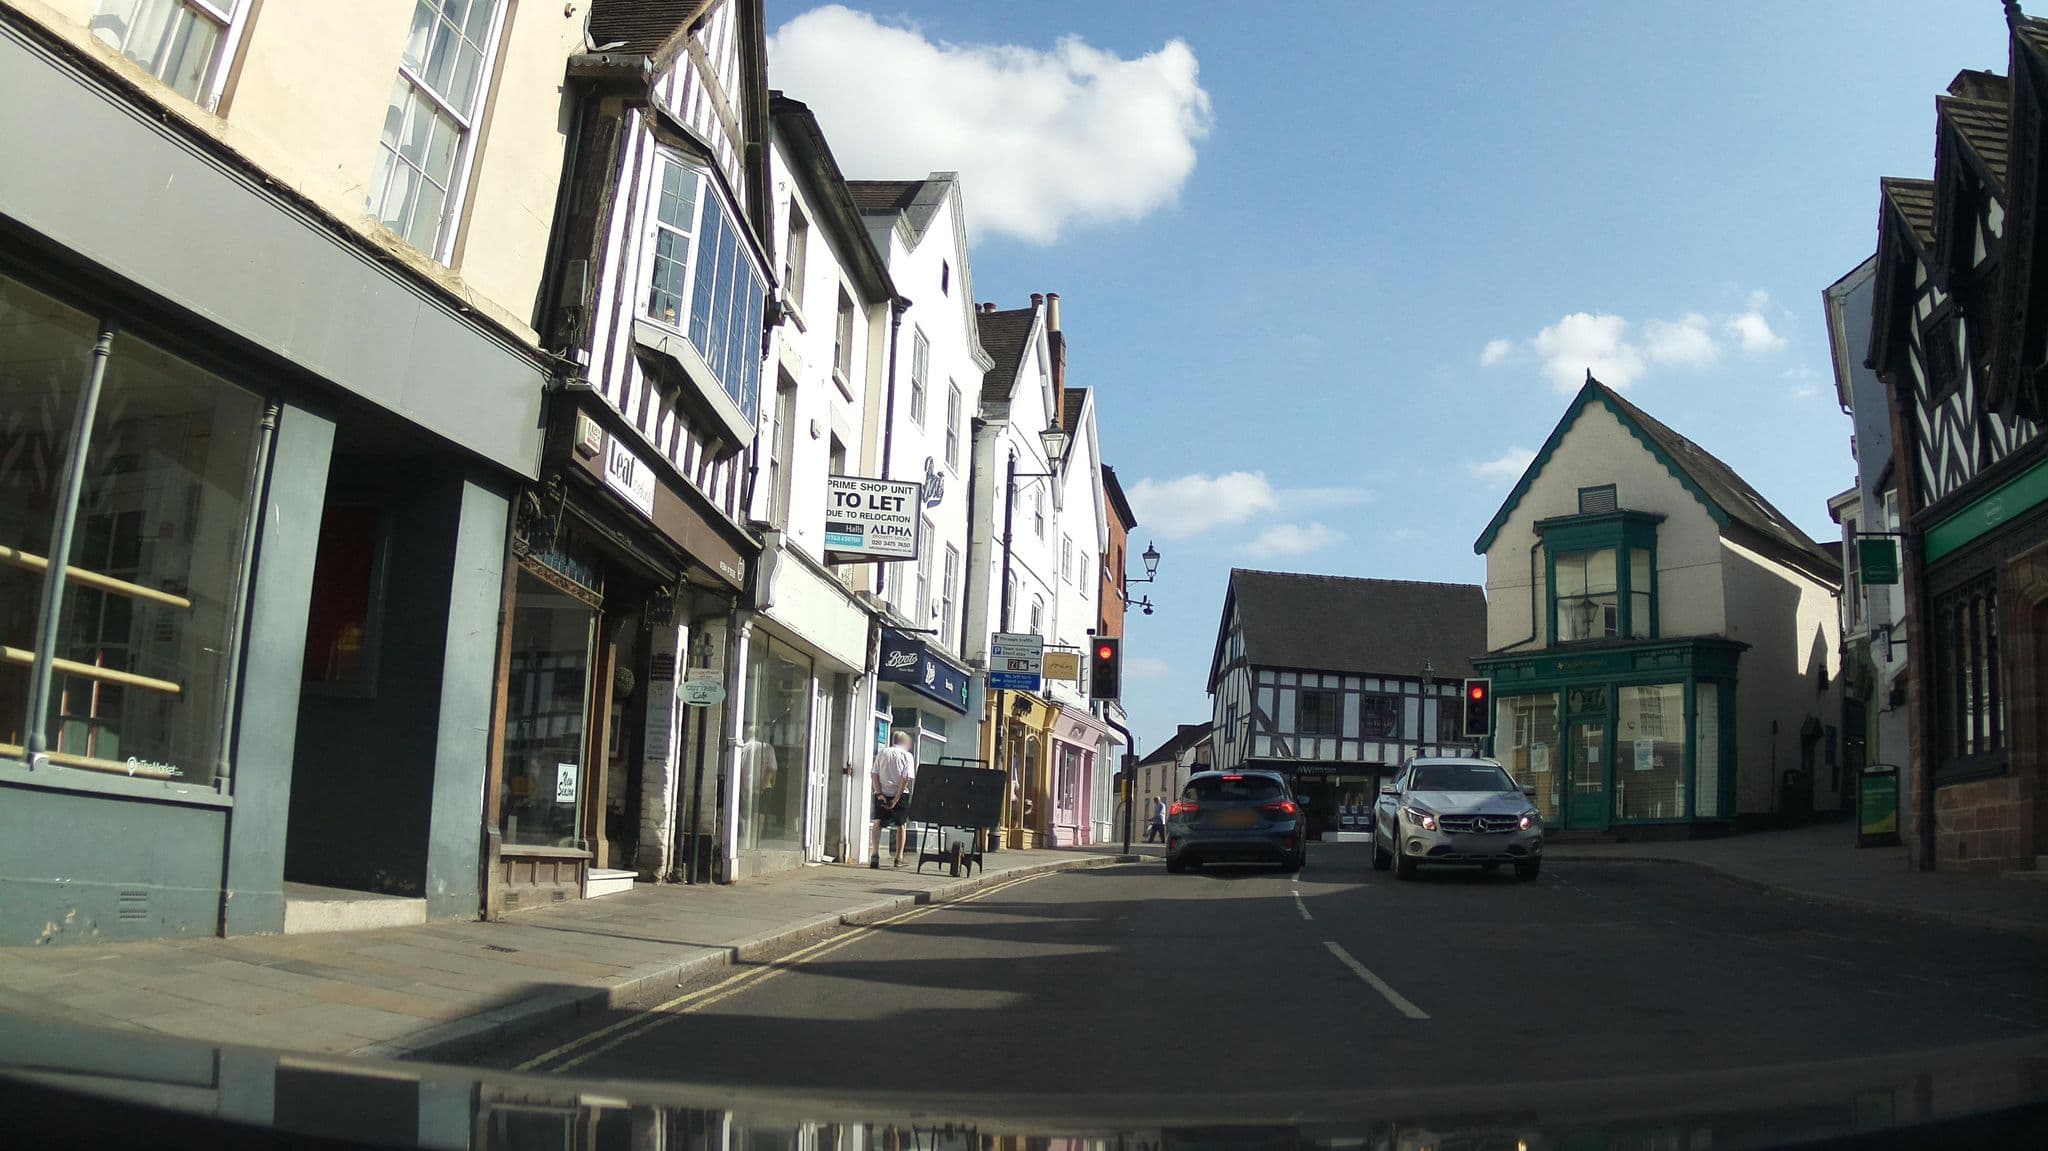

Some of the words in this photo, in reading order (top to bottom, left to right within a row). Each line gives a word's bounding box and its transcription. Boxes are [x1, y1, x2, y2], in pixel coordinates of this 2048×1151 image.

[609, 439, 636, 489] Leaf
[860, 482, 888, 493] SHOP
[891, 485, 914, 495] UNIT
[834, 491, 862, 508] TO
[869, 494, 905, 512] LET
[826, 509, 843, 517] DUE
[846, 510, 857, 519] TO
[859, 512, 911, 523] RELOCATION
[870, 524, 912, 537] ALPHA
[885, 650, 918, 668] Boots
